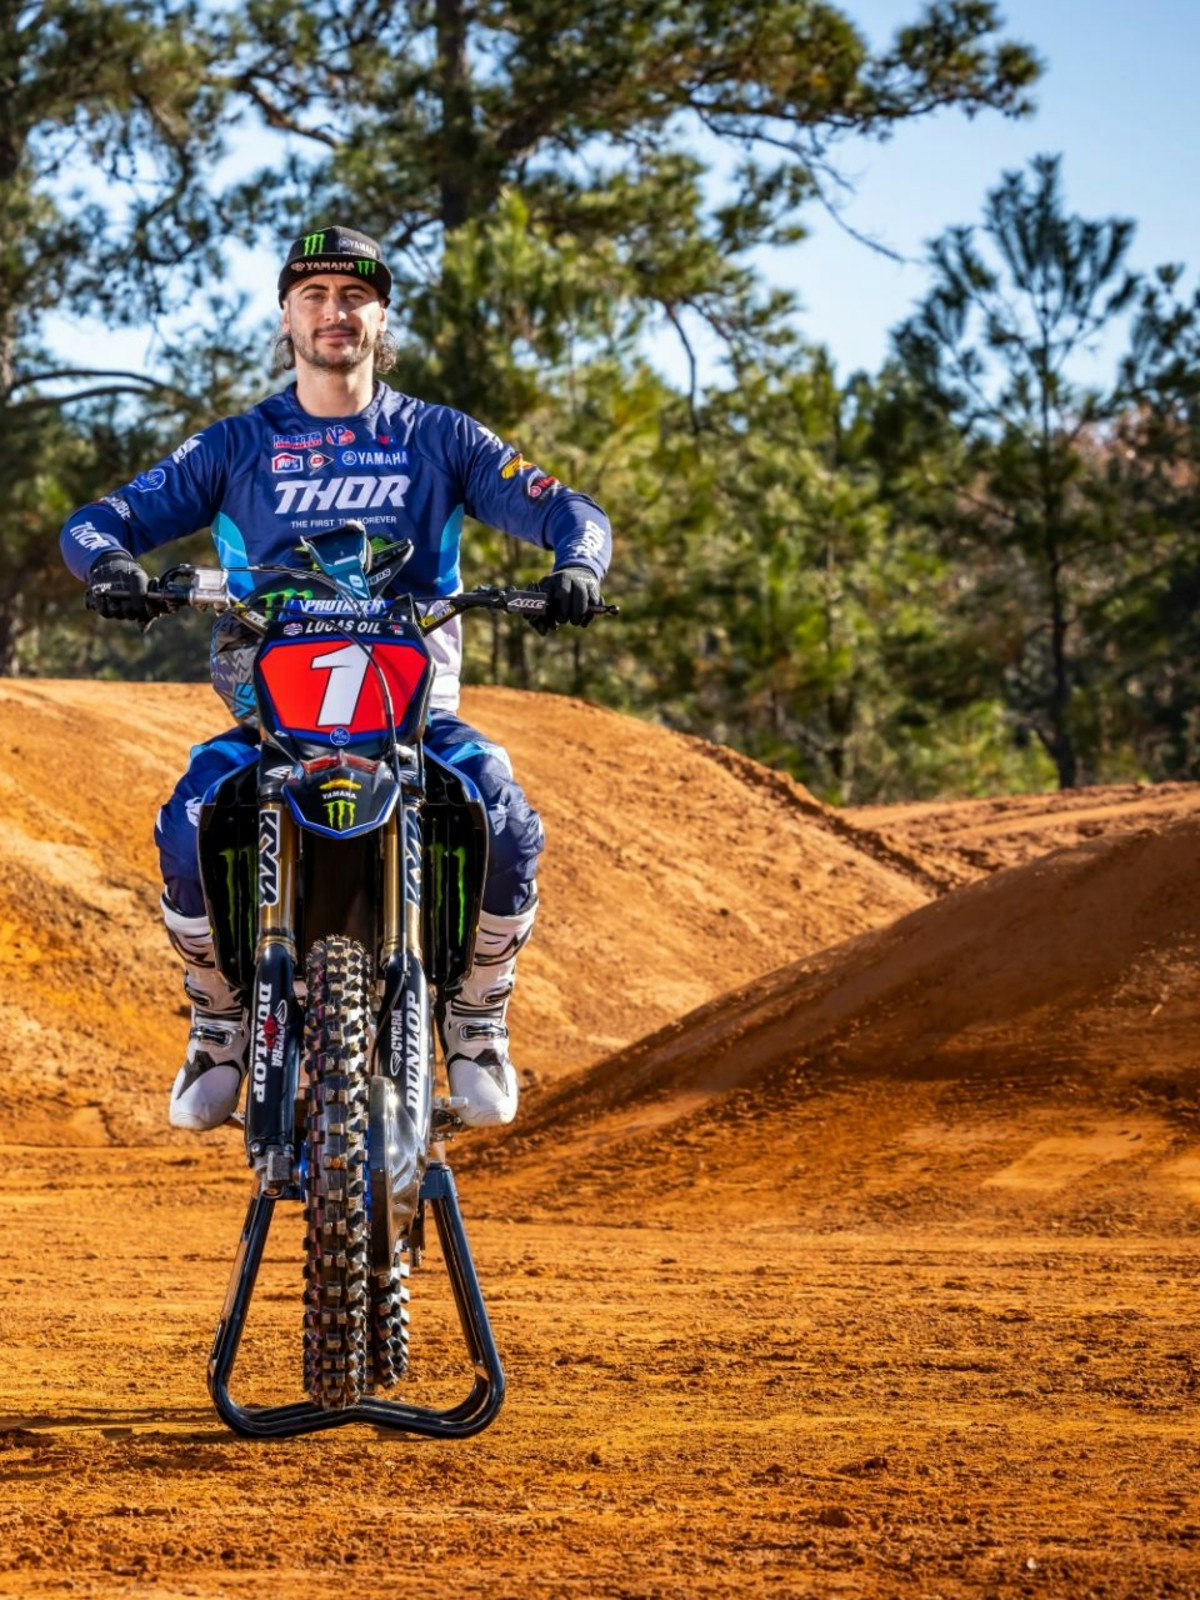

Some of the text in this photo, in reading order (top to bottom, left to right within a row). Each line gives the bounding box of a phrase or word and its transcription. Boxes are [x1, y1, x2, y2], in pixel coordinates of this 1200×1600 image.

[305, 262, 355, 271] YAMAHA
[357, 450, 409, 466] YAMAHA
[274, 475, 411, 515] THOR
[291, 520, 308, 529] THE
[310, 519, 335, 528] FIRST
[357, 621, 381, 634] OIL
[311, 643, 374, 727] 1
[322, 790, 358, 800] YAMAHA
[253, 982, 273, 1104] DUNLOP
[390, 1009, 404, 1052] CYCRA
[405, 990, 422, 1109] DUNLOP
